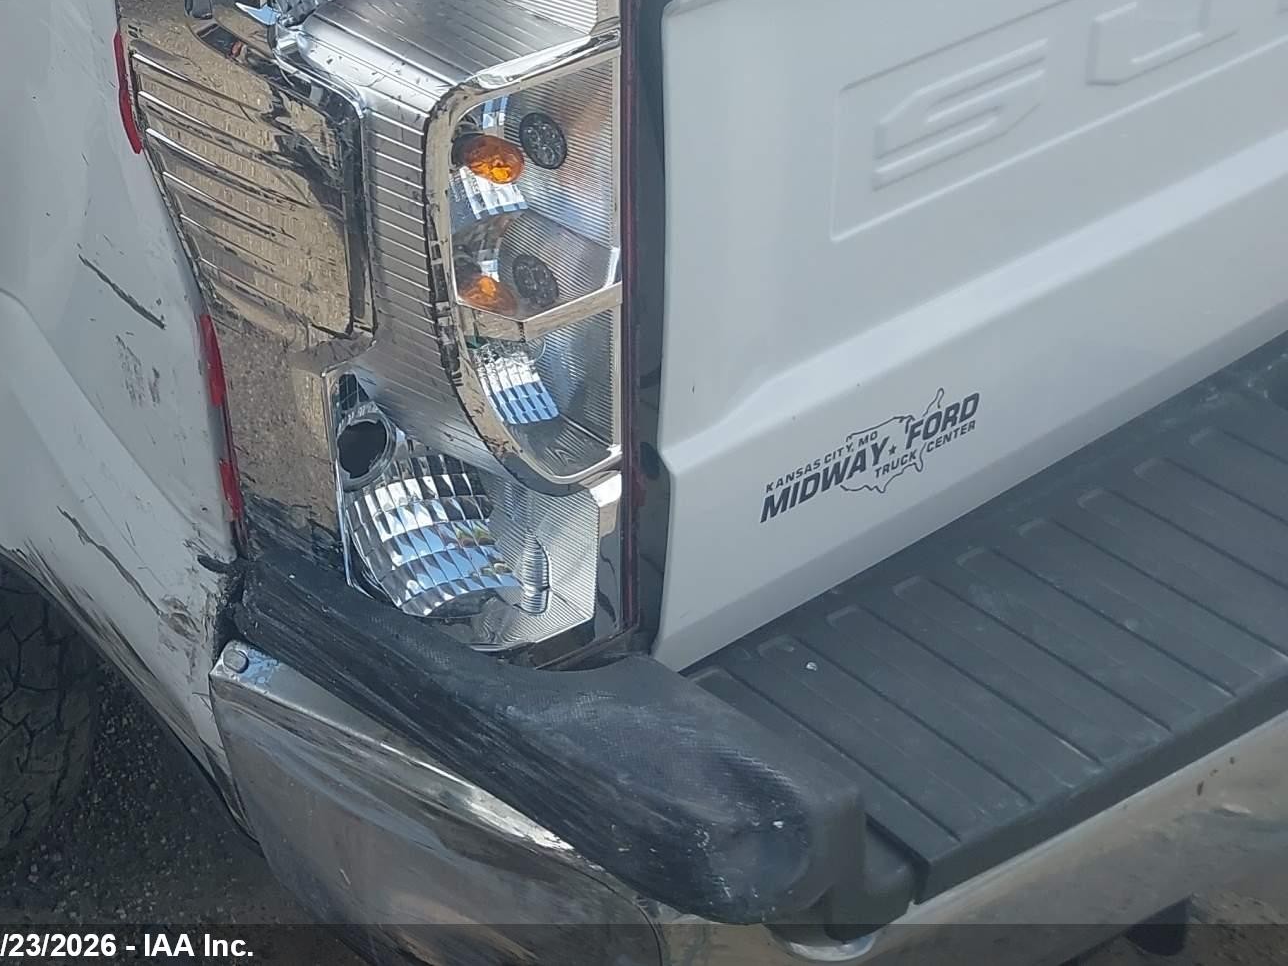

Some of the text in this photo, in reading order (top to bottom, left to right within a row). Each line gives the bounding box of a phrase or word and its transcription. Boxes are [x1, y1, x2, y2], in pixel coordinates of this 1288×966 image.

[760, 392, 979, 523] MIDWAY FORD
[766, 458, 821, 493] KANSAS
[858, 430, 878, 447] MO
[875, 420, 976, 478] TRUCK CENTER
